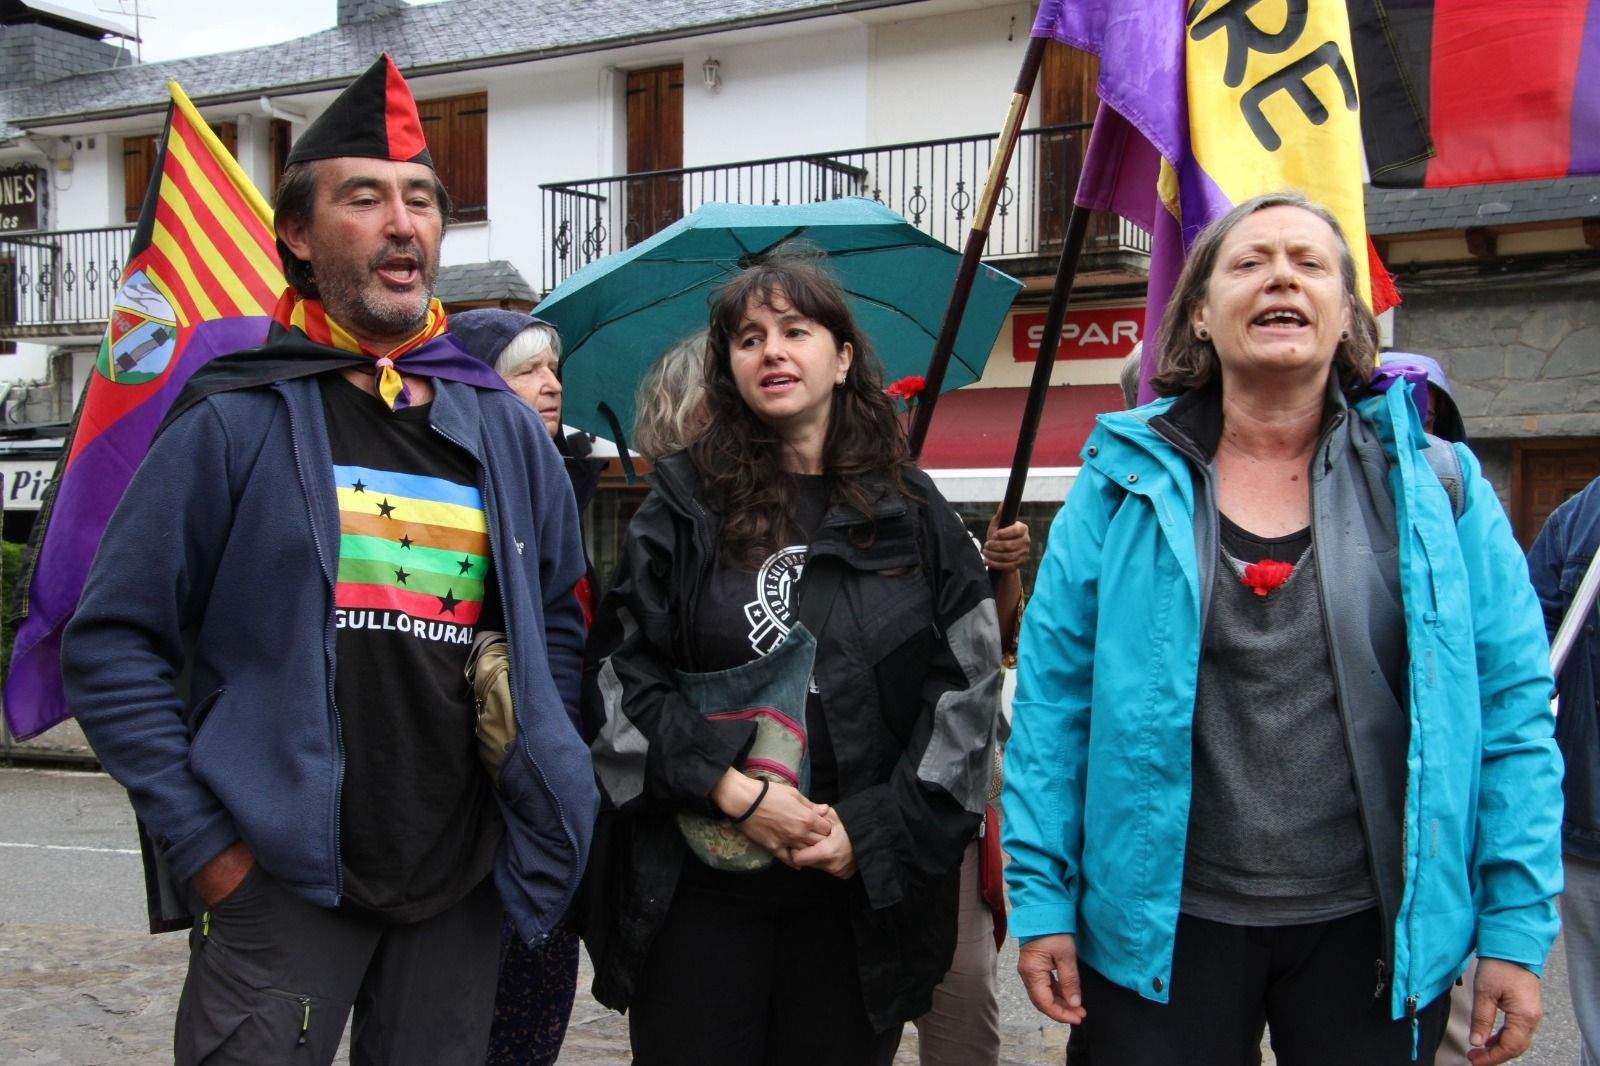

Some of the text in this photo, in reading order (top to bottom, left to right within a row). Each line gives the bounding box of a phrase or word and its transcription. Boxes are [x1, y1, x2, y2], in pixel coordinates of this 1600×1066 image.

[1186, 0, 1358, 152] RE
[0, 174, 35, 205] NES
[1027, 320, 1139, 349] SPAR
[766, 584, 778, 596] DE
[770, 600, 791, 621] RED
